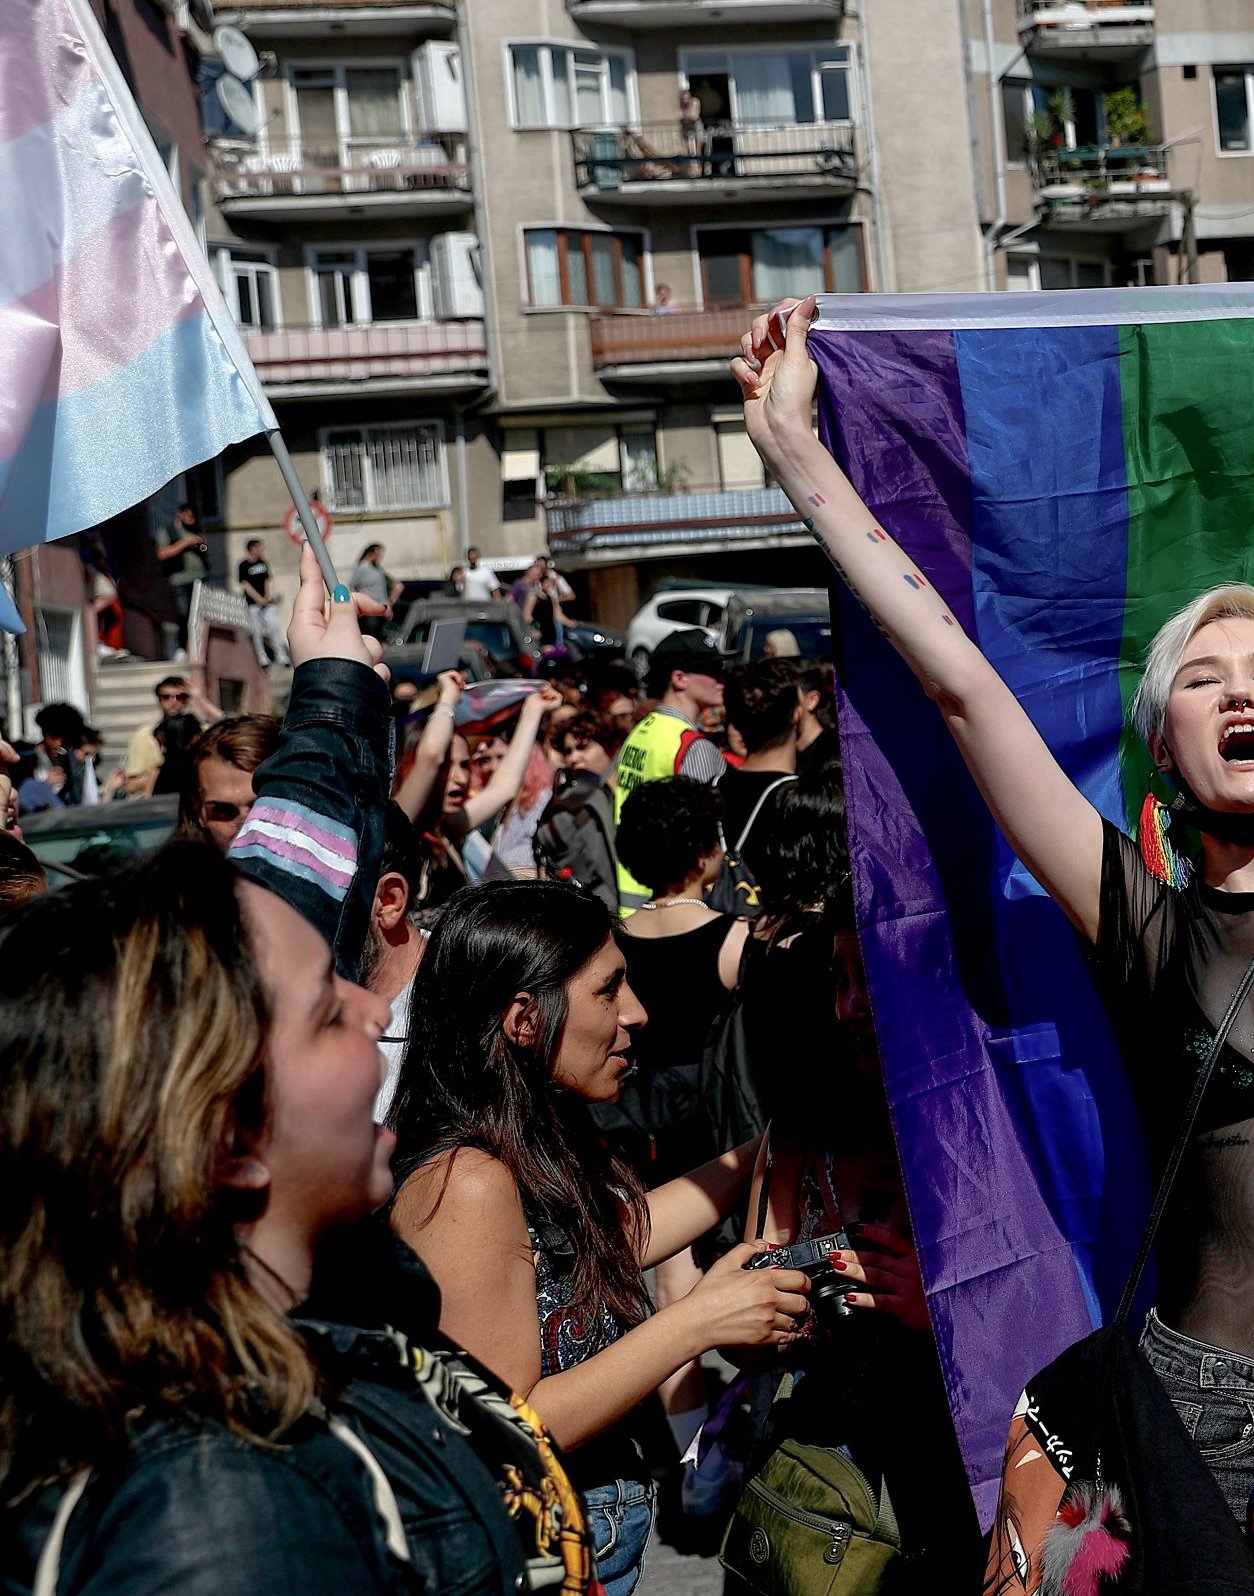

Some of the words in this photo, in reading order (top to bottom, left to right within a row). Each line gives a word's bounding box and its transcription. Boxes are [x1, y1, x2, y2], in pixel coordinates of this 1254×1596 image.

[1027, 1396, 1074, 1479] アッカーマ
